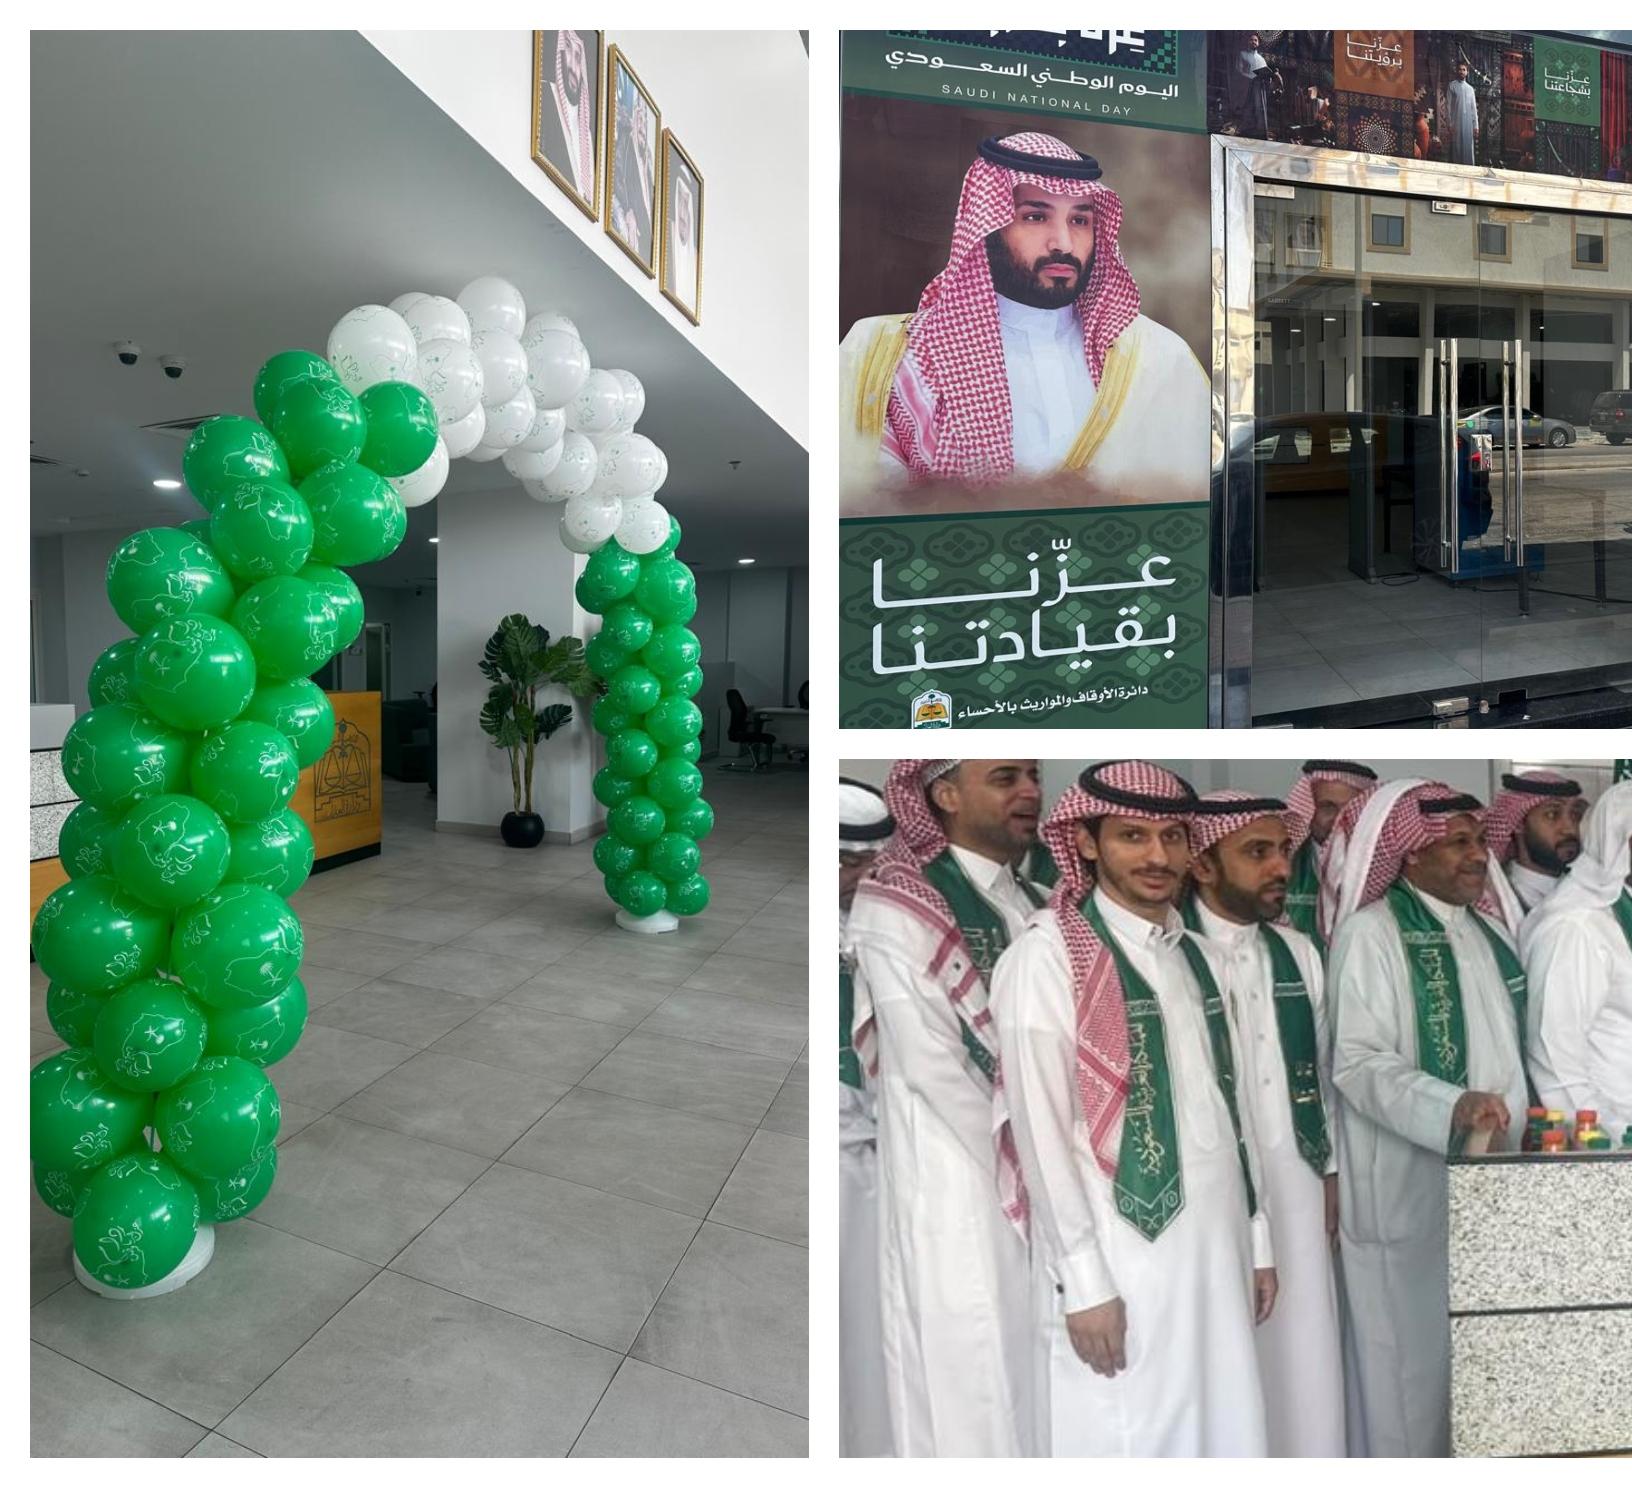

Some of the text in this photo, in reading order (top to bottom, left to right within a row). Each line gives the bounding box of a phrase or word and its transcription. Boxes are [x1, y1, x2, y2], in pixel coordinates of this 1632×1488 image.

[884, 49, 1179, 101] اليوم الوطني السعودي
[1544, 78, 1591, 99] بشجاعتنا
[941, 84, 1132, 117] SAUDI NATIONAL DAY
[872, 605, 1177, 675] بقيادتنا
[1072, 687, 1118, 704] الأوقاف
[1118, 684, 1149, 698] دائرة
[957, 698, 1018, 720] بالأحساء
[1019, 693, 1072, 711] والمواريث
